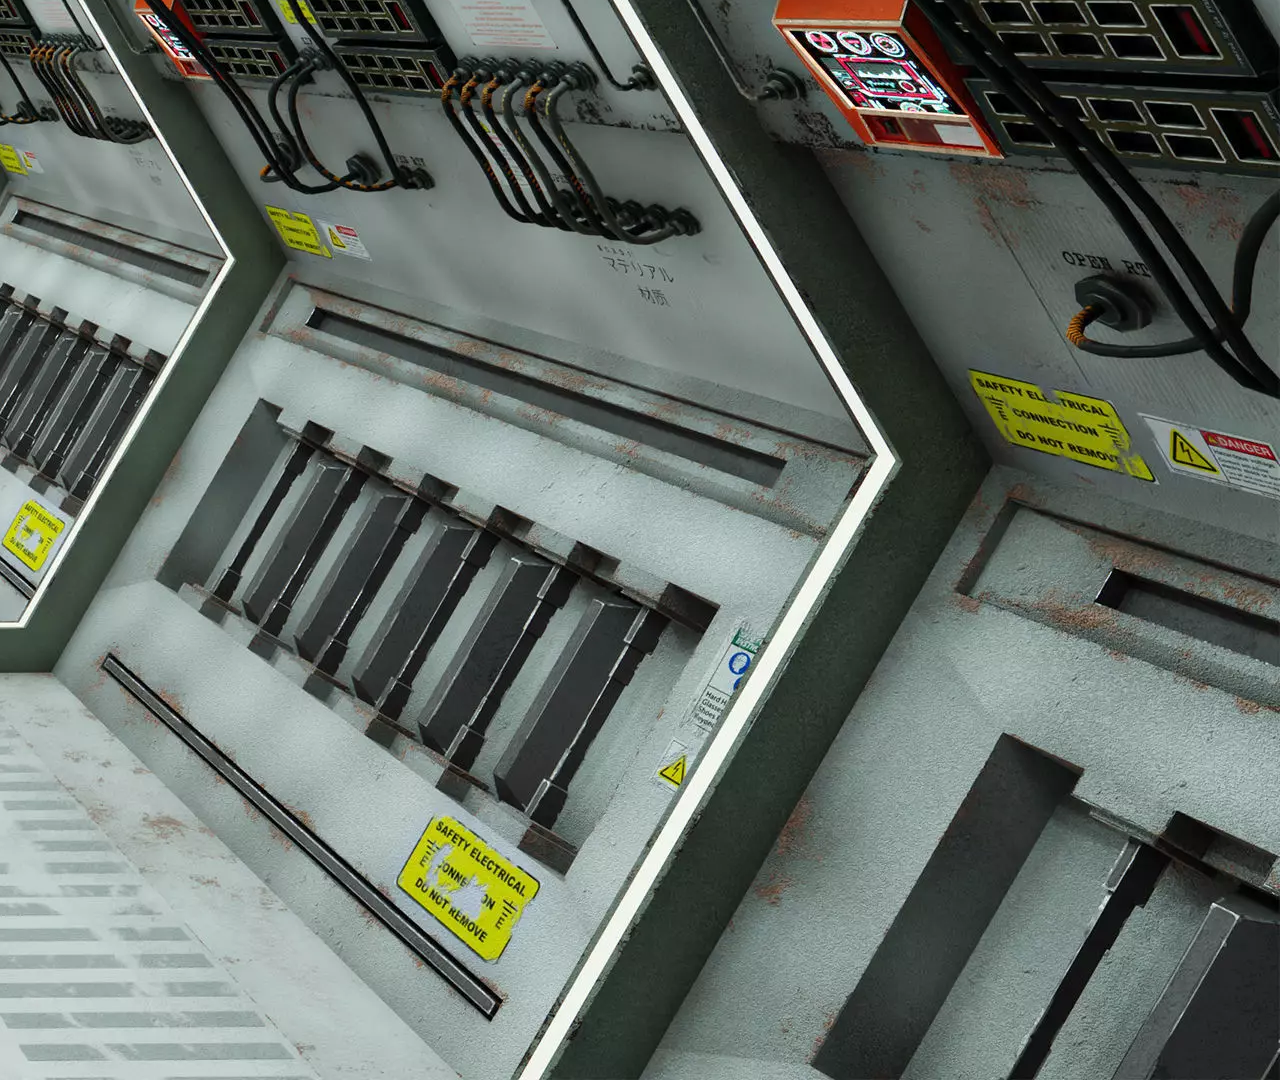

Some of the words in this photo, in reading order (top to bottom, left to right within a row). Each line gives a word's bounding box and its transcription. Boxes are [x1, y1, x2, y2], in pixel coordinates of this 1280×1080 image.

[603, 256, 674, 283] マテリアル
[1062, 251, 1112, 271] OPEN
[1121, 259, 1151, 278] RT
[976, 377, 1023, 396] SAFETY
[1029, 390, 1110, 419] ELETRICAL
[1012, 406, 1099, 438] CONNECTION
[1017, 429, 1038, 443] DO
[1040, 435, 1065, 450] NOT
[1068, 443, 1124, 466] REMOV
[1216, 435, 1272, 459] DANGER
[705, 690, 721, 704] Hard
[697, 706, 716, 720] Shoes
[434, 820, 472, 852] SAFETY
[469, 846, 529, 898] ELECTRICAL
[414, 877, 431, 894] DO
[427, 888, 450, 910] NOT
[447, 905, 489, 944] REMOVE
